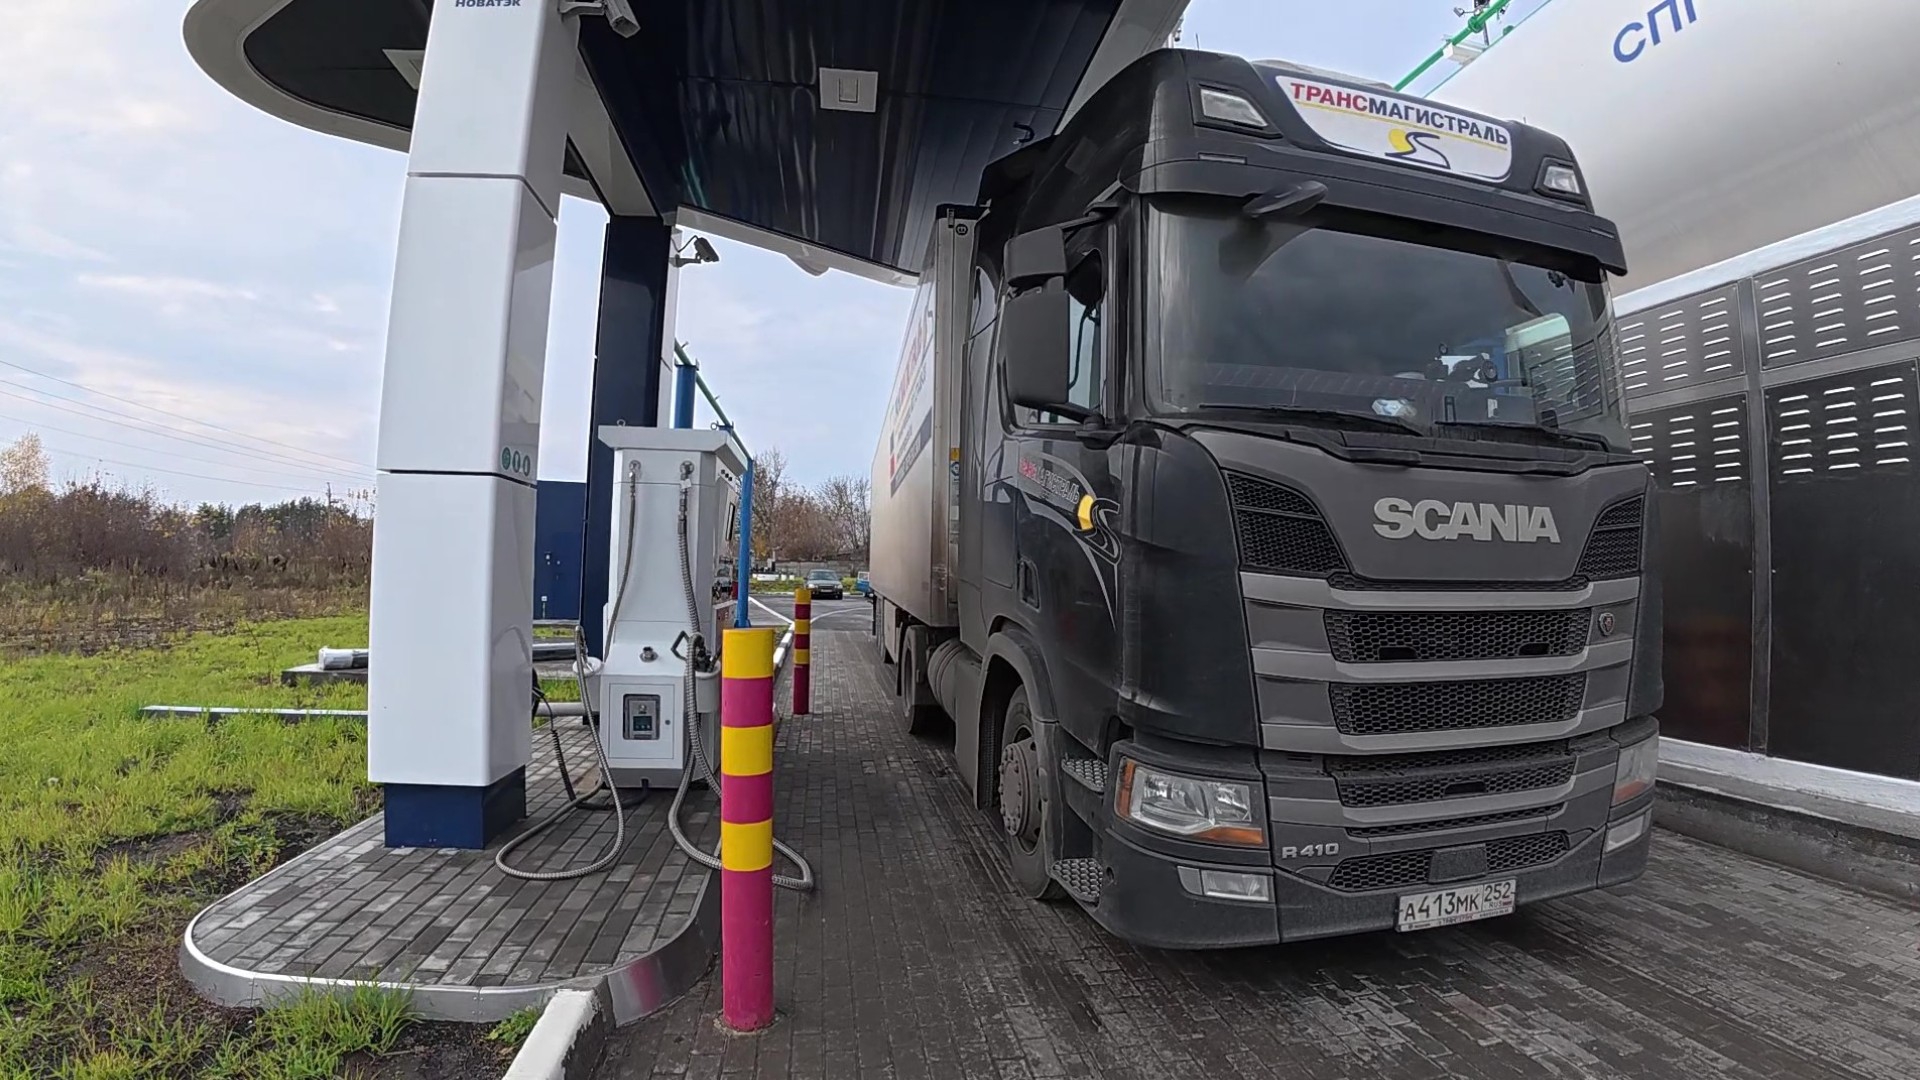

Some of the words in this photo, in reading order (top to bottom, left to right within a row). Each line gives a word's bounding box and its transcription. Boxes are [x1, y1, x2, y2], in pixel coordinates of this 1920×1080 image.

[455, 0, 521, 8] НОВАТЭК
[1290, 82, 1508, 145] ТРАНСМАГИСТРАЛЬ
[1373, 497, 1561, 543] SCANIA
